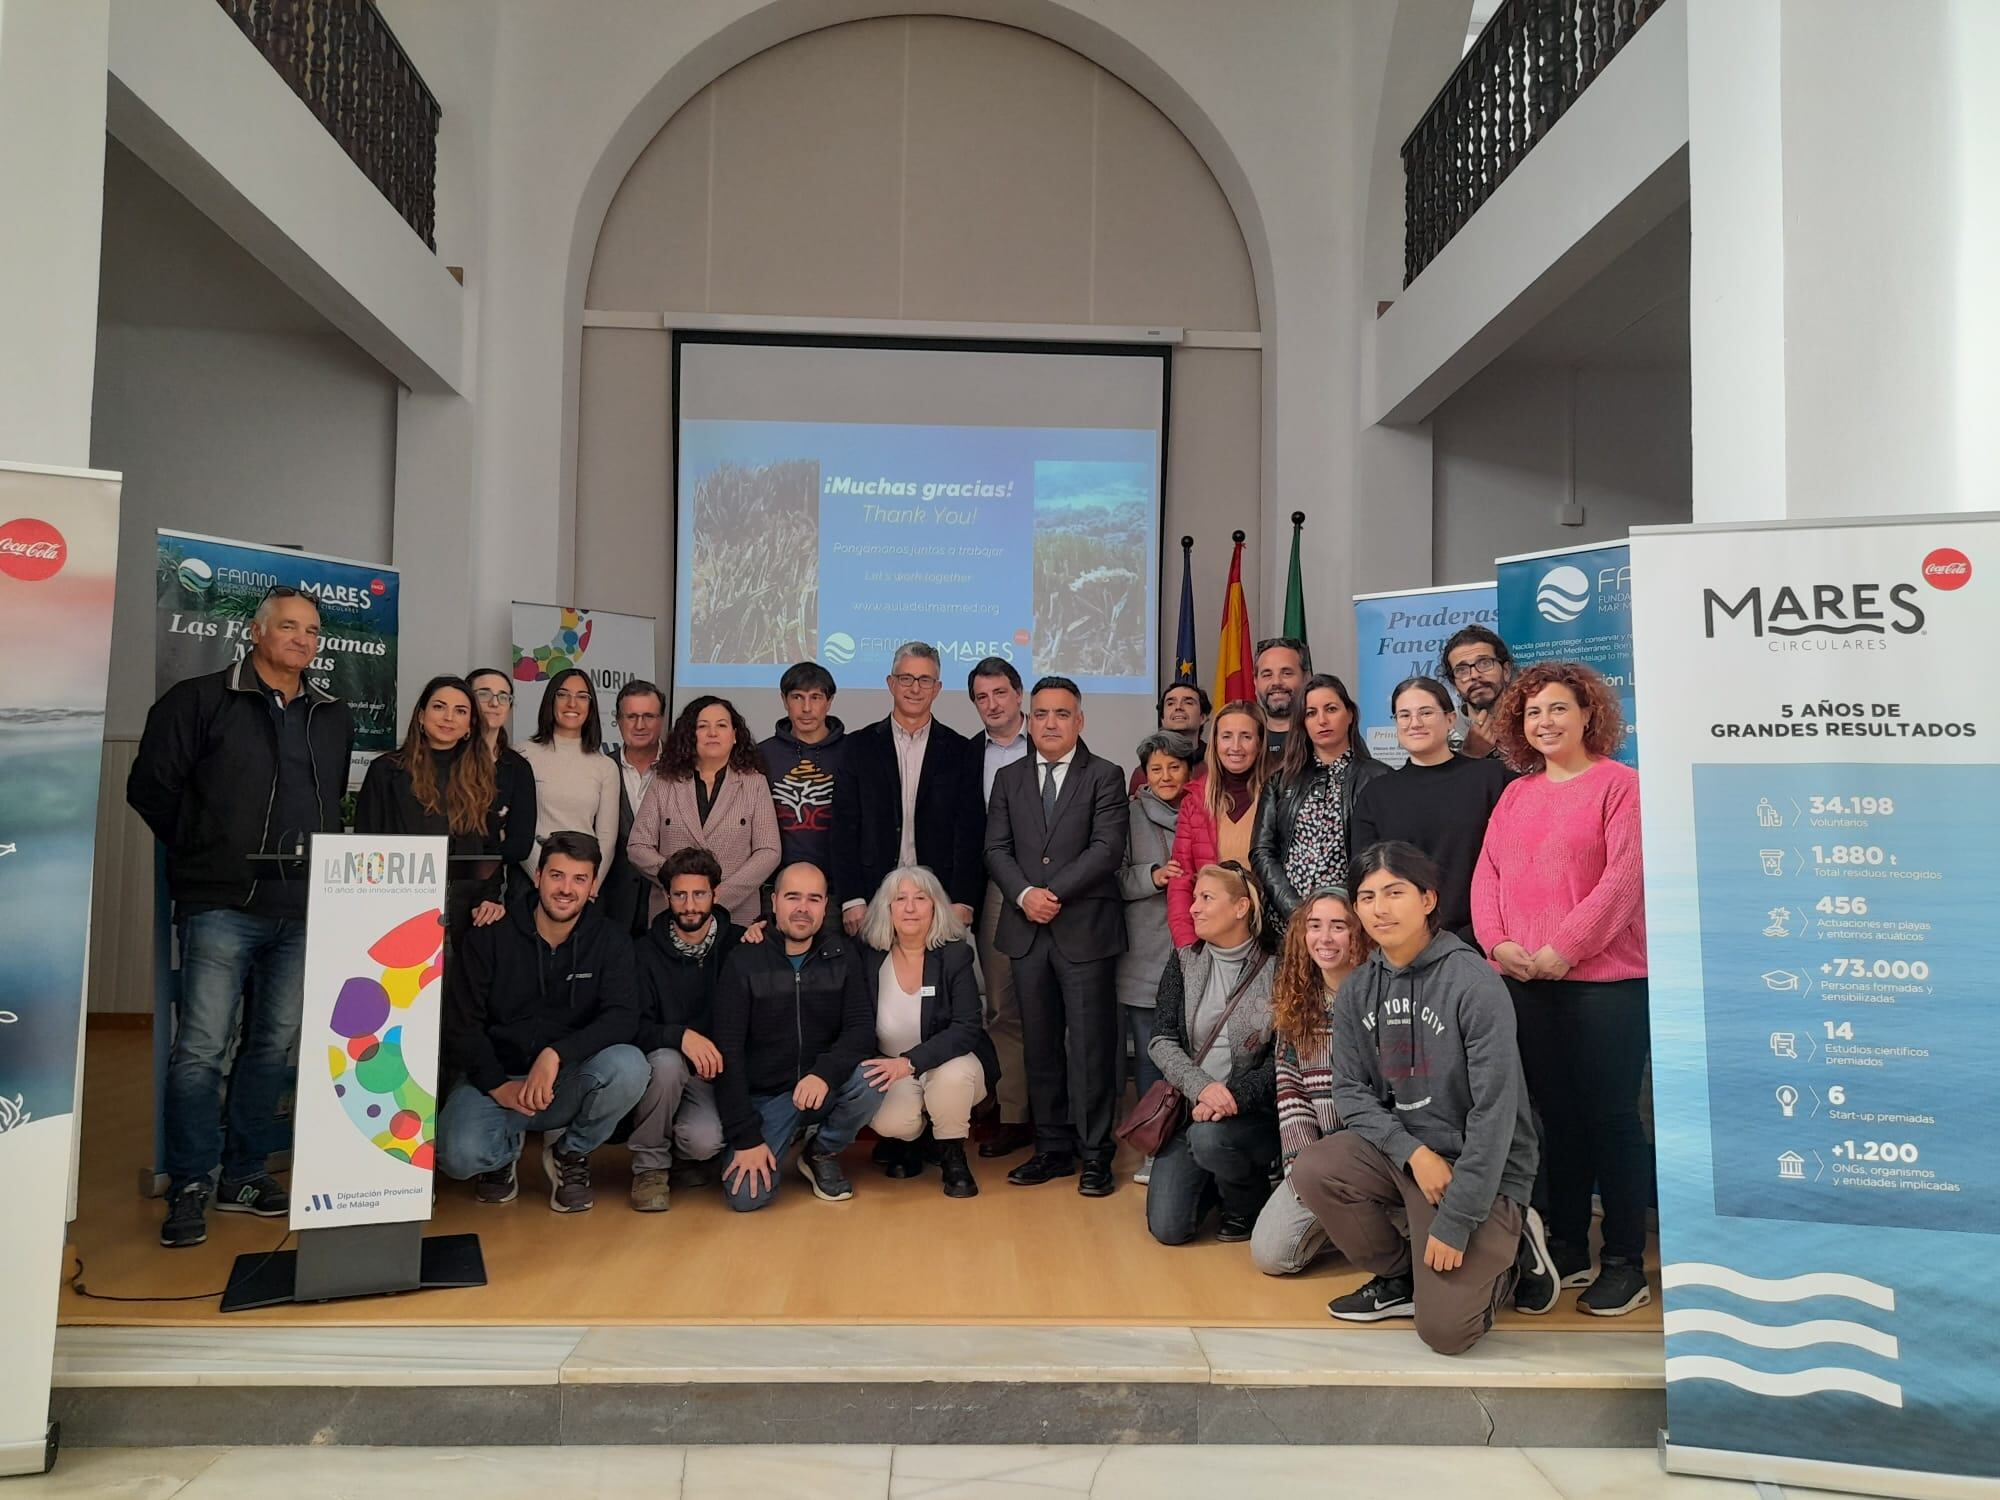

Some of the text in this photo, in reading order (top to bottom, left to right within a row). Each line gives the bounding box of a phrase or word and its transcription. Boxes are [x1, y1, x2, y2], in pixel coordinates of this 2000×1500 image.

[824, 476, 1014, 500] ¡Muchas gracias!
[864, 504, 978, 525] Thank You!
[301, 580, 371, 609] MARES
[1387, 606, 1499, 630] Praderas
[1703, 583, 1925, 638] MARES
[168, 614, 218, 637] Las
[937, 640, 1014, 662] MARES
[1534, 642, 1551, 650] para
[1768, 638, 1887, 652] CIRCULARES
[1781, 700, 1901, 718] 5 AÑOS DE
[1711, 722, 1977, 738] GRANDES RESULTADOS
[1809, 796, 1895, 816] 34.198
[1812, 845, 1897, 866] 1.880 t
[324, 852, 437, 884] LA NORIA
[1814, 867, 1943, 881] Total residuos recogidos
[357, 886, 367, 894] de
[1815, 896, 1868, 915] 456
[1817, 919, 1931, 933] Actuaciones en playas
[1827, 930, 1873, 940] entornos
[1820, 958, 1929, 980] +73.000
[1820, 981, 1871, 991] Personas
[1873, 982, 1924, 993] formadas
[1821, 992, 1895, 1004] sensibilizadas
[1421, 1006, 1445, 1036] CITY
[1824, 1021, 1854, 1040] 14
[1825, 1043, 1872, 1055] Estudios
[1826, 1057, 1883, 1067] premiados
[1828, 1086, 1846, 1105] 6
[1829, 1110, 1936, 1125] Start-up premiadas
[1831, 1140, 1919, 1163] +1.200
[1832, 1163, 1935, 1179] ONGs, organismos
[337, 1186, 423, 1201] Diputación Provincial
[1842, 1176, 1897, 1189] entidades
[1899, 1179, 1961, 1193] implicadas
[336, 1199, 380, 1210] de Málaga
